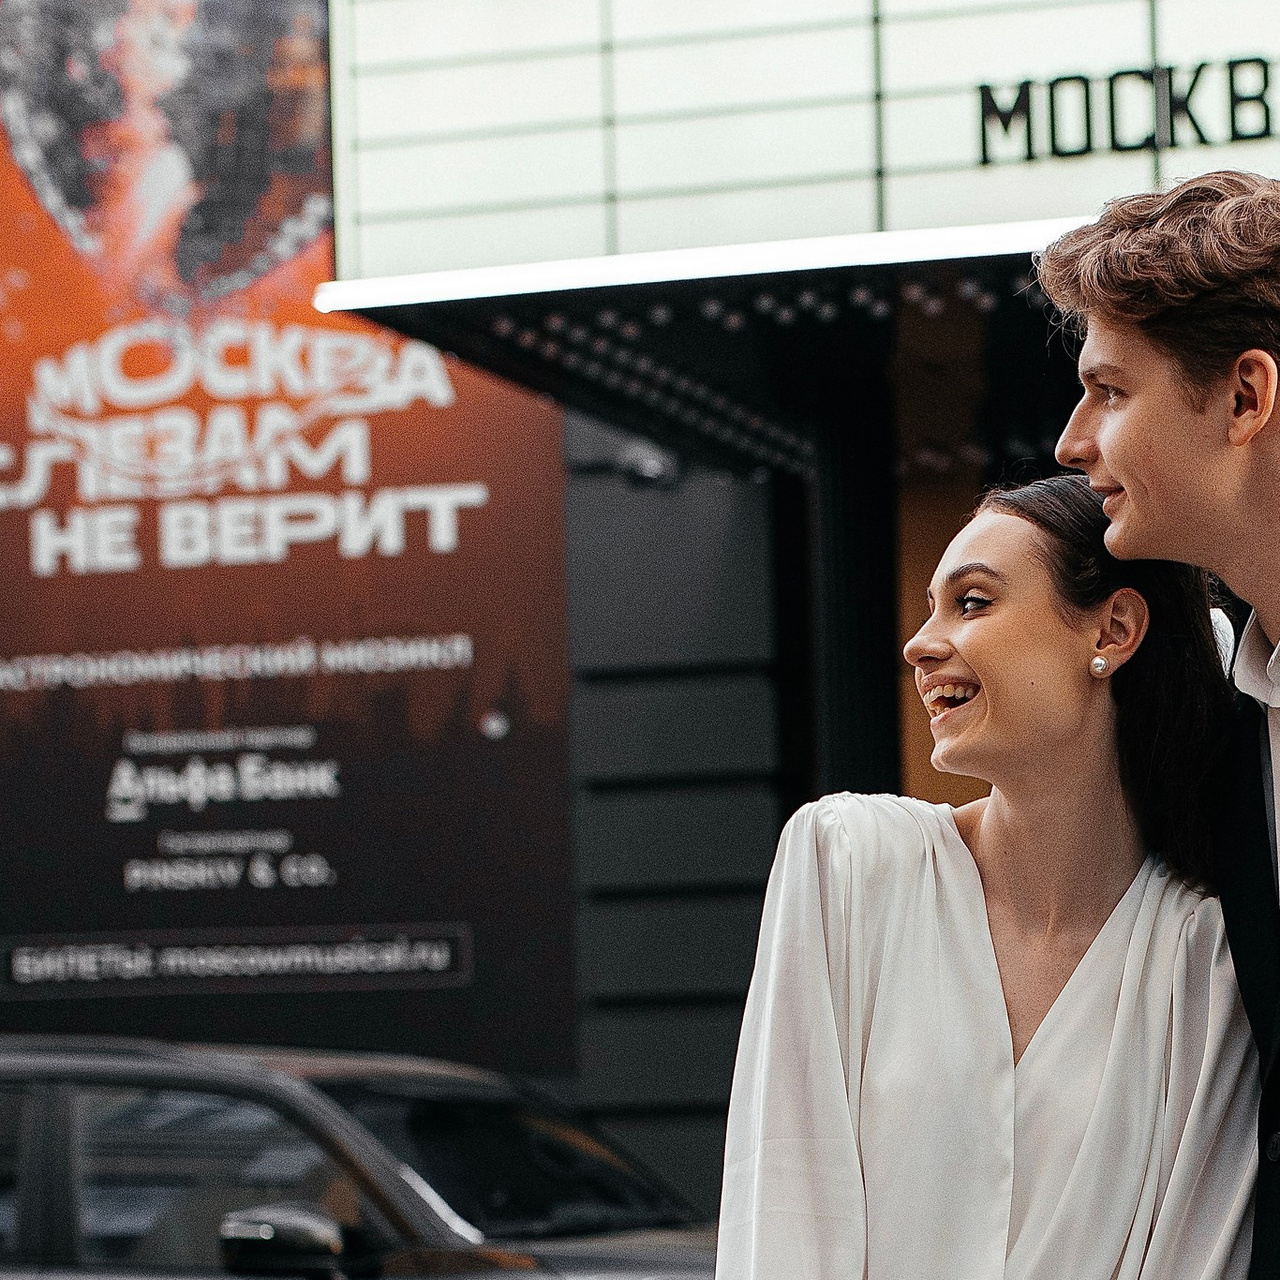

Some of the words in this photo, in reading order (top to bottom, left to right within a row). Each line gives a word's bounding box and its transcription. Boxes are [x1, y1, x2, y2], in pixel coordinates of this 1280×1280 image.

[28, 317, 457, 418] МОСКВА
[29, 500, 142, 578] НЕ
[157, 479, 490, 569] ВЕРИТ
[107, 758, 236, 820] Альфа
[237, 753, 341, 800] Банк
